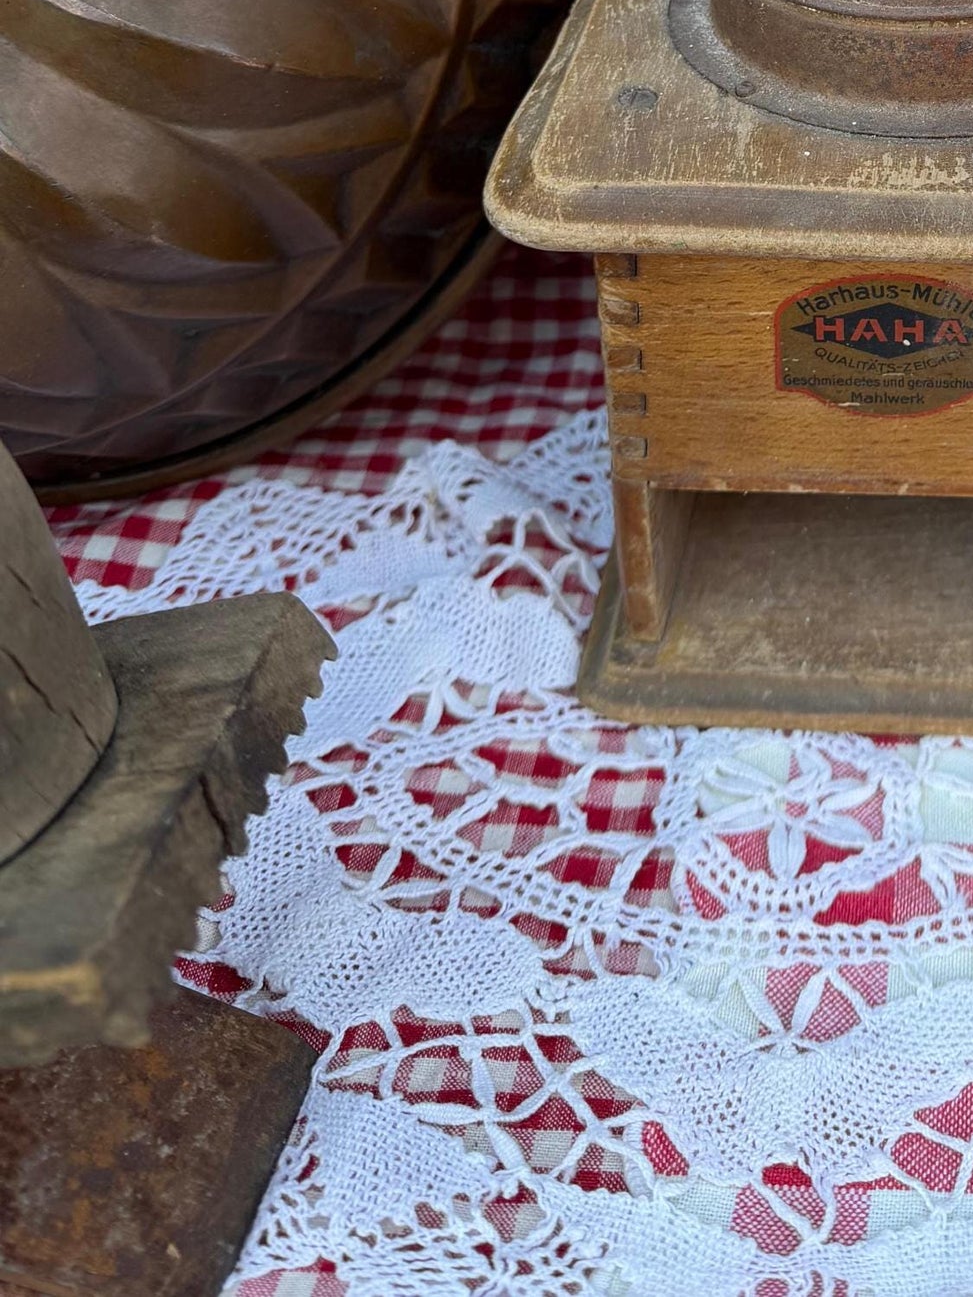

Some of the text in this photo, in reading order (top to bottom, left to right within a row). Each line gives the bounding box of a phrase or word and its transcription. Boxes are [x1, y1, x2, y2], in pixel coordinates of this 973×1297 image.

[814, 317, 969, 344] HAHA
[783, 374, 881, 387] Geschmiedetes
[883, 375, 905, 388] und
[851, 392, 925, 404] Mahlwerk
